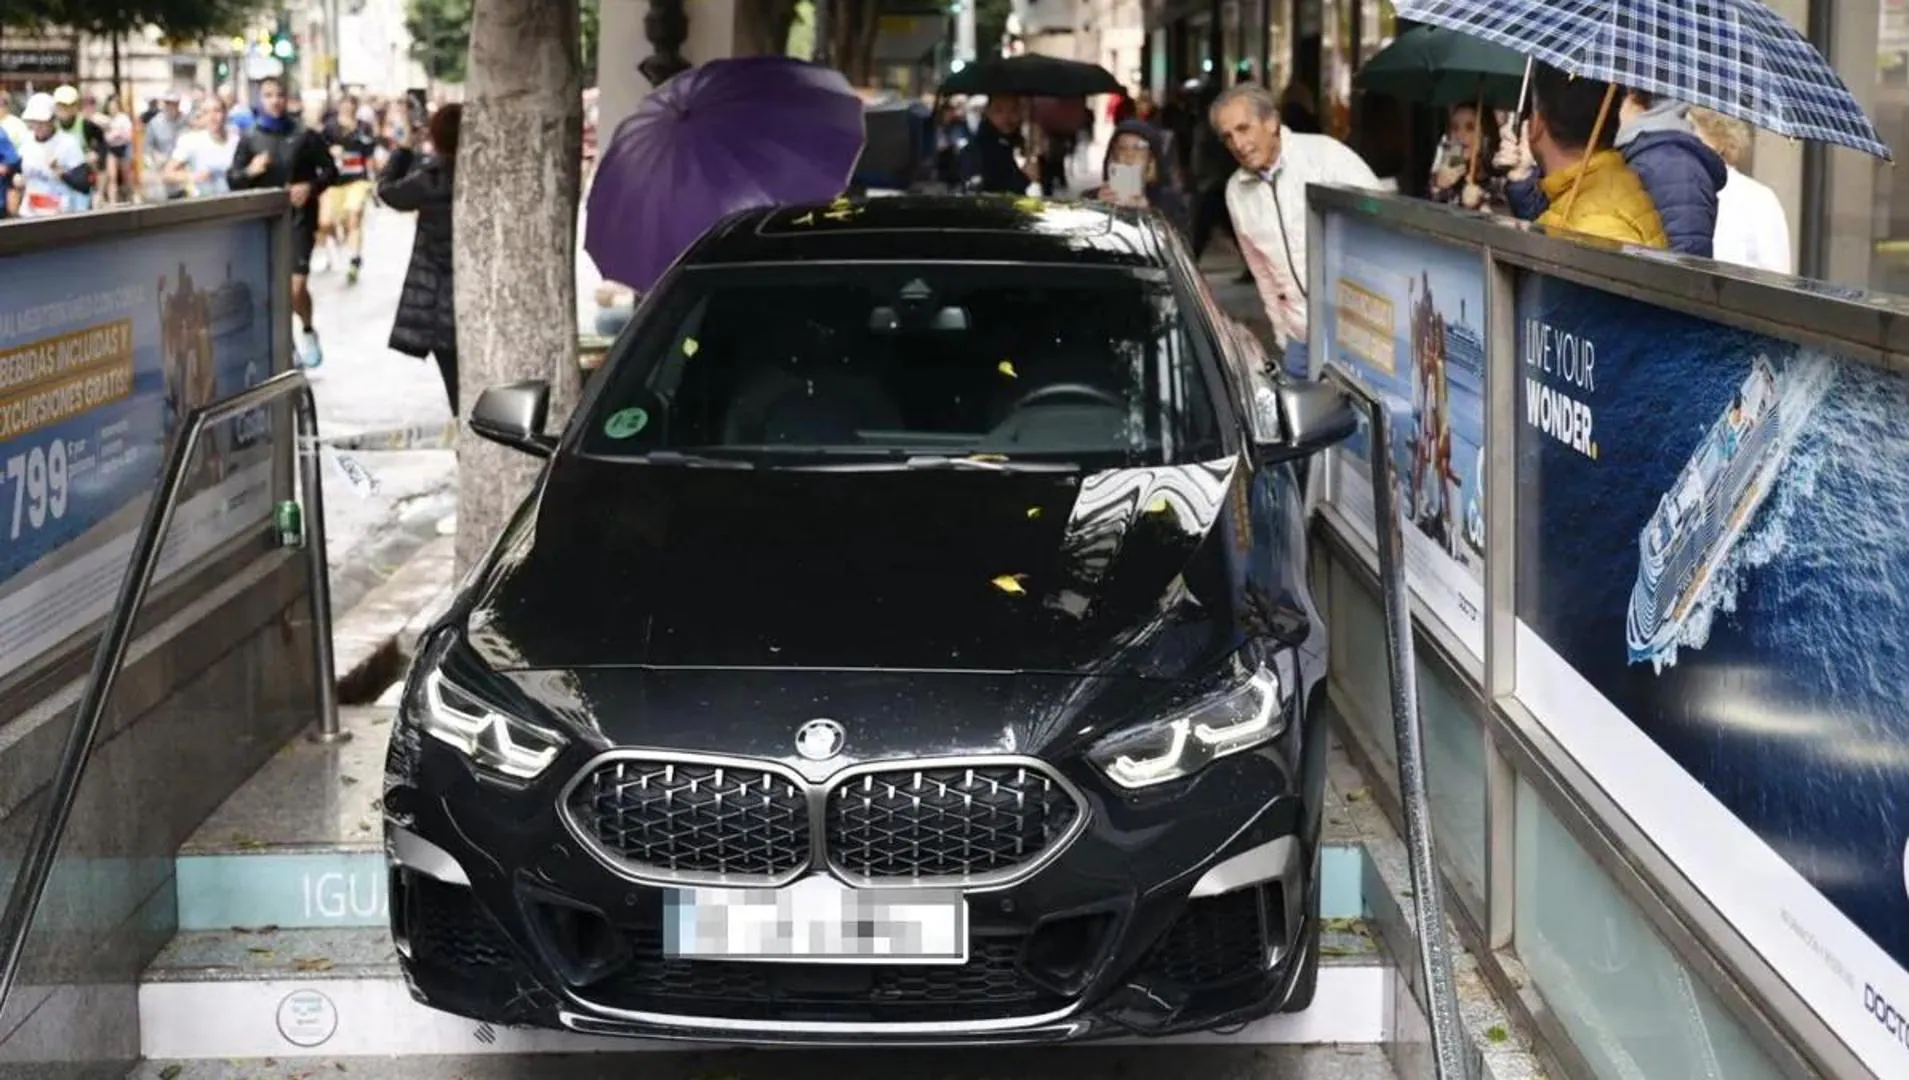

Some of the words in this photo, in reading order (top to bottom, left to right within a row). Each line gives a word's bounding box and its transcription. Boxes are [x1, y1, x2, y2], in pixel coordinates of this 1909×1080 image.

[57, 325, 117, 372] INCLUIDAS
[1526, 317, 1551, 373] LIVE
[1555, 329, 1594, 392] YOUR
[1526, 377, 1598, 460] WONDER.
[7, 438, 67, 540] 799
[304, 872, 389, 919] IGU
